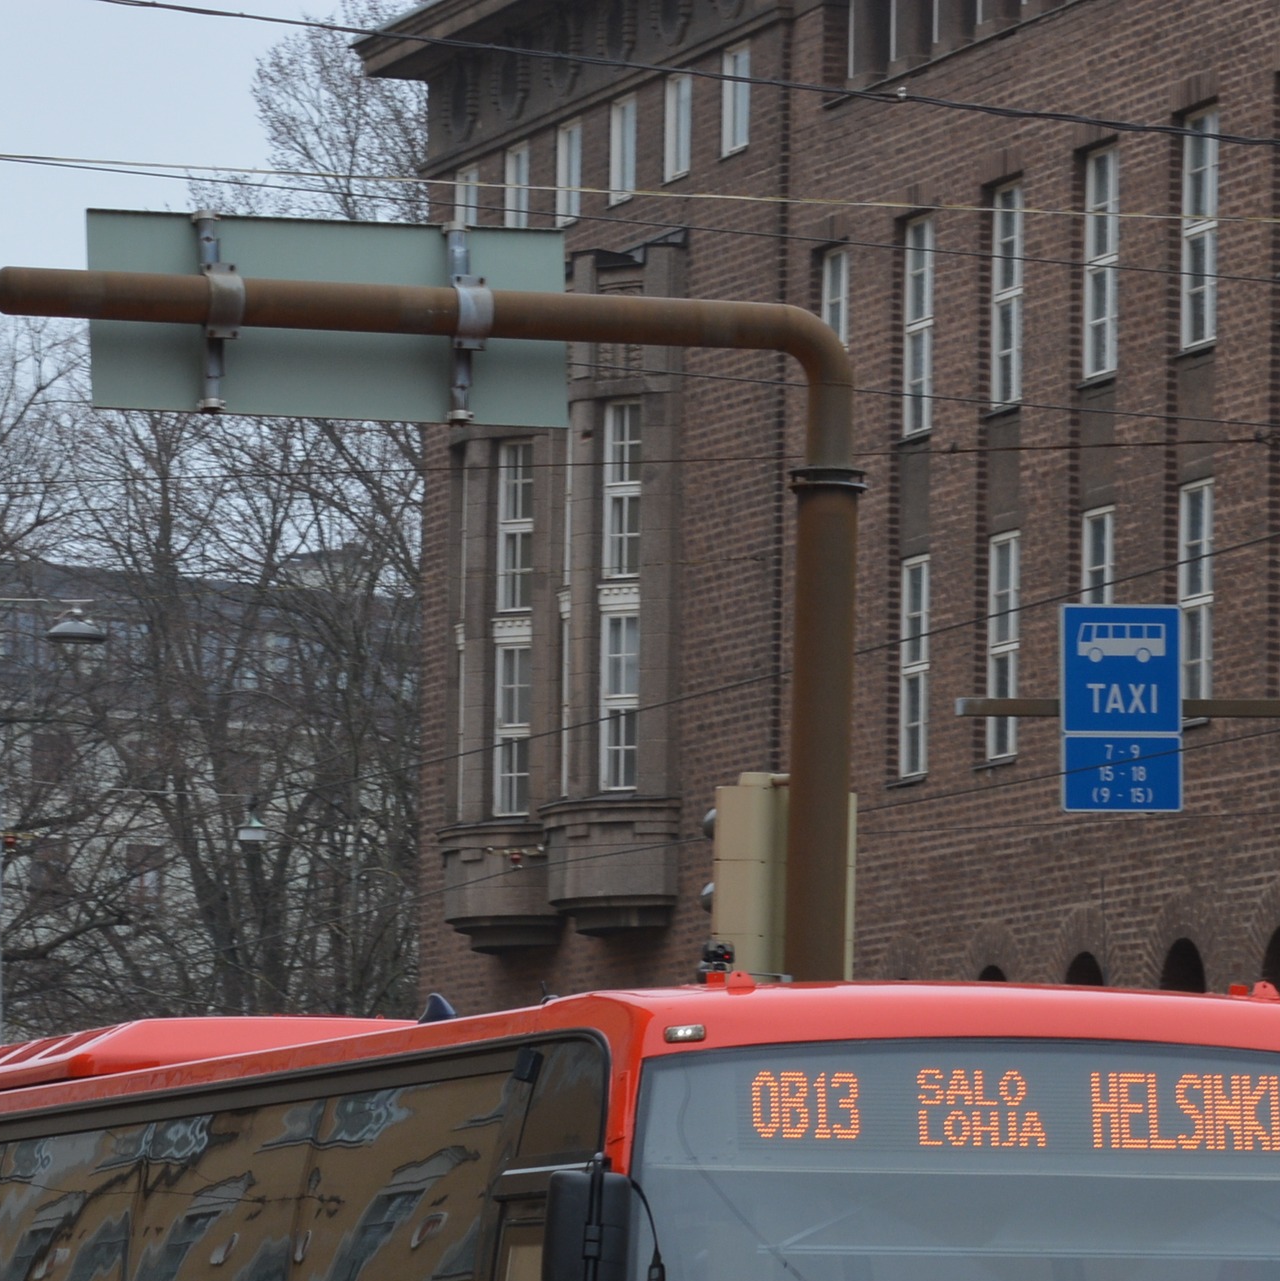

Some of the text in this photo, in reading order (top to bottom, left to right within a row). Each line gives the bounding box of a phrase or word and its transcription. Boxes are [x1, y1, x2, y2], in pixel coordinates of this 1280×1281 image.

[1086, 683, 1158, 714] TAXI
[1104, 744, 1114, 760] 7
[1129, 744, 1141, 759] 9
[1099, 766, 1114, 782] 15
[1131, 766, 1147, 781] 18
[1092, 787, 1110, 803] (9
[1130, 787, 1153, 803] 15)
[916, 1068, 1027, 1106] SALO
[918, 1109, 1047, 1147] LOHJA
